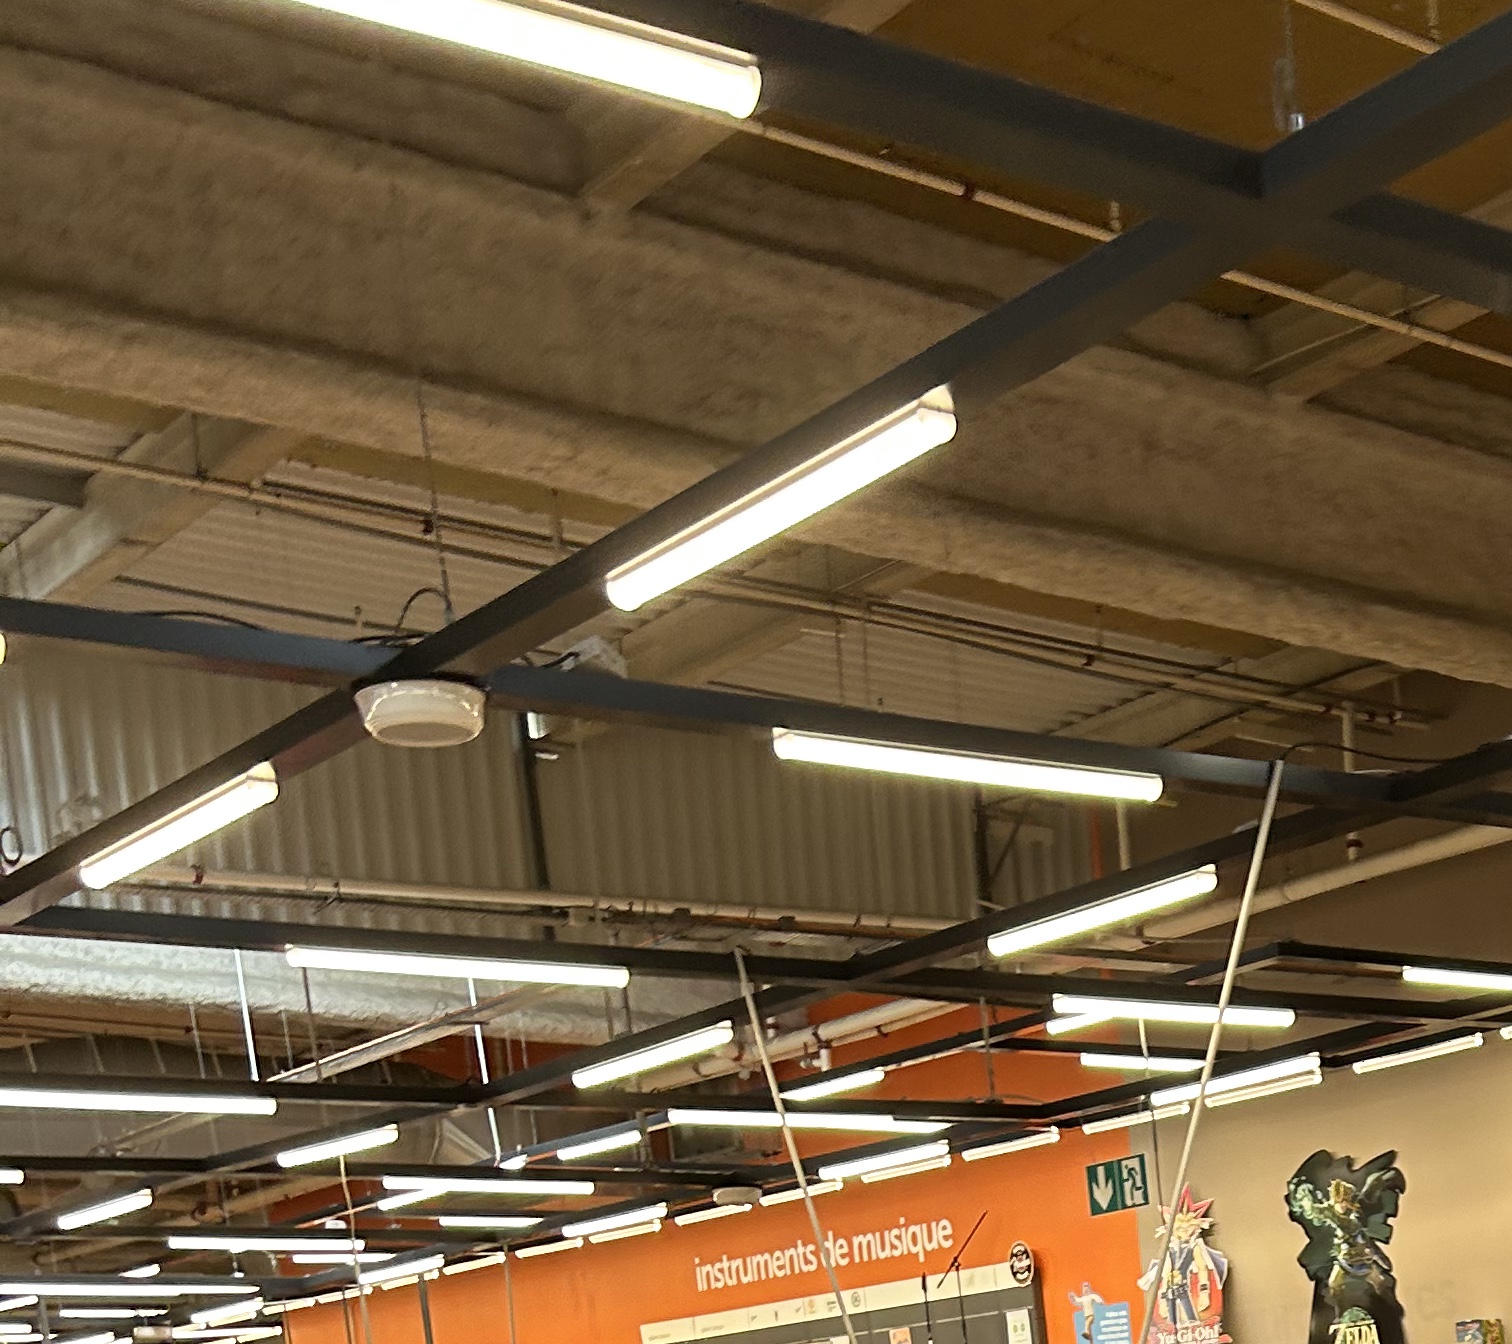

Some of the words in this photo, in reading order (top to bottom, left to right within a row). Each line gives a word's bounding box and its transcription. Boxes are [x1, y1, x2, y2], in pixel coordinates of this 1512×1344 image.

[694, 1240, 818, 1292] instruments
[822, 1230, 849, 1268] de
[852, 1217, 954, 1272] musique
